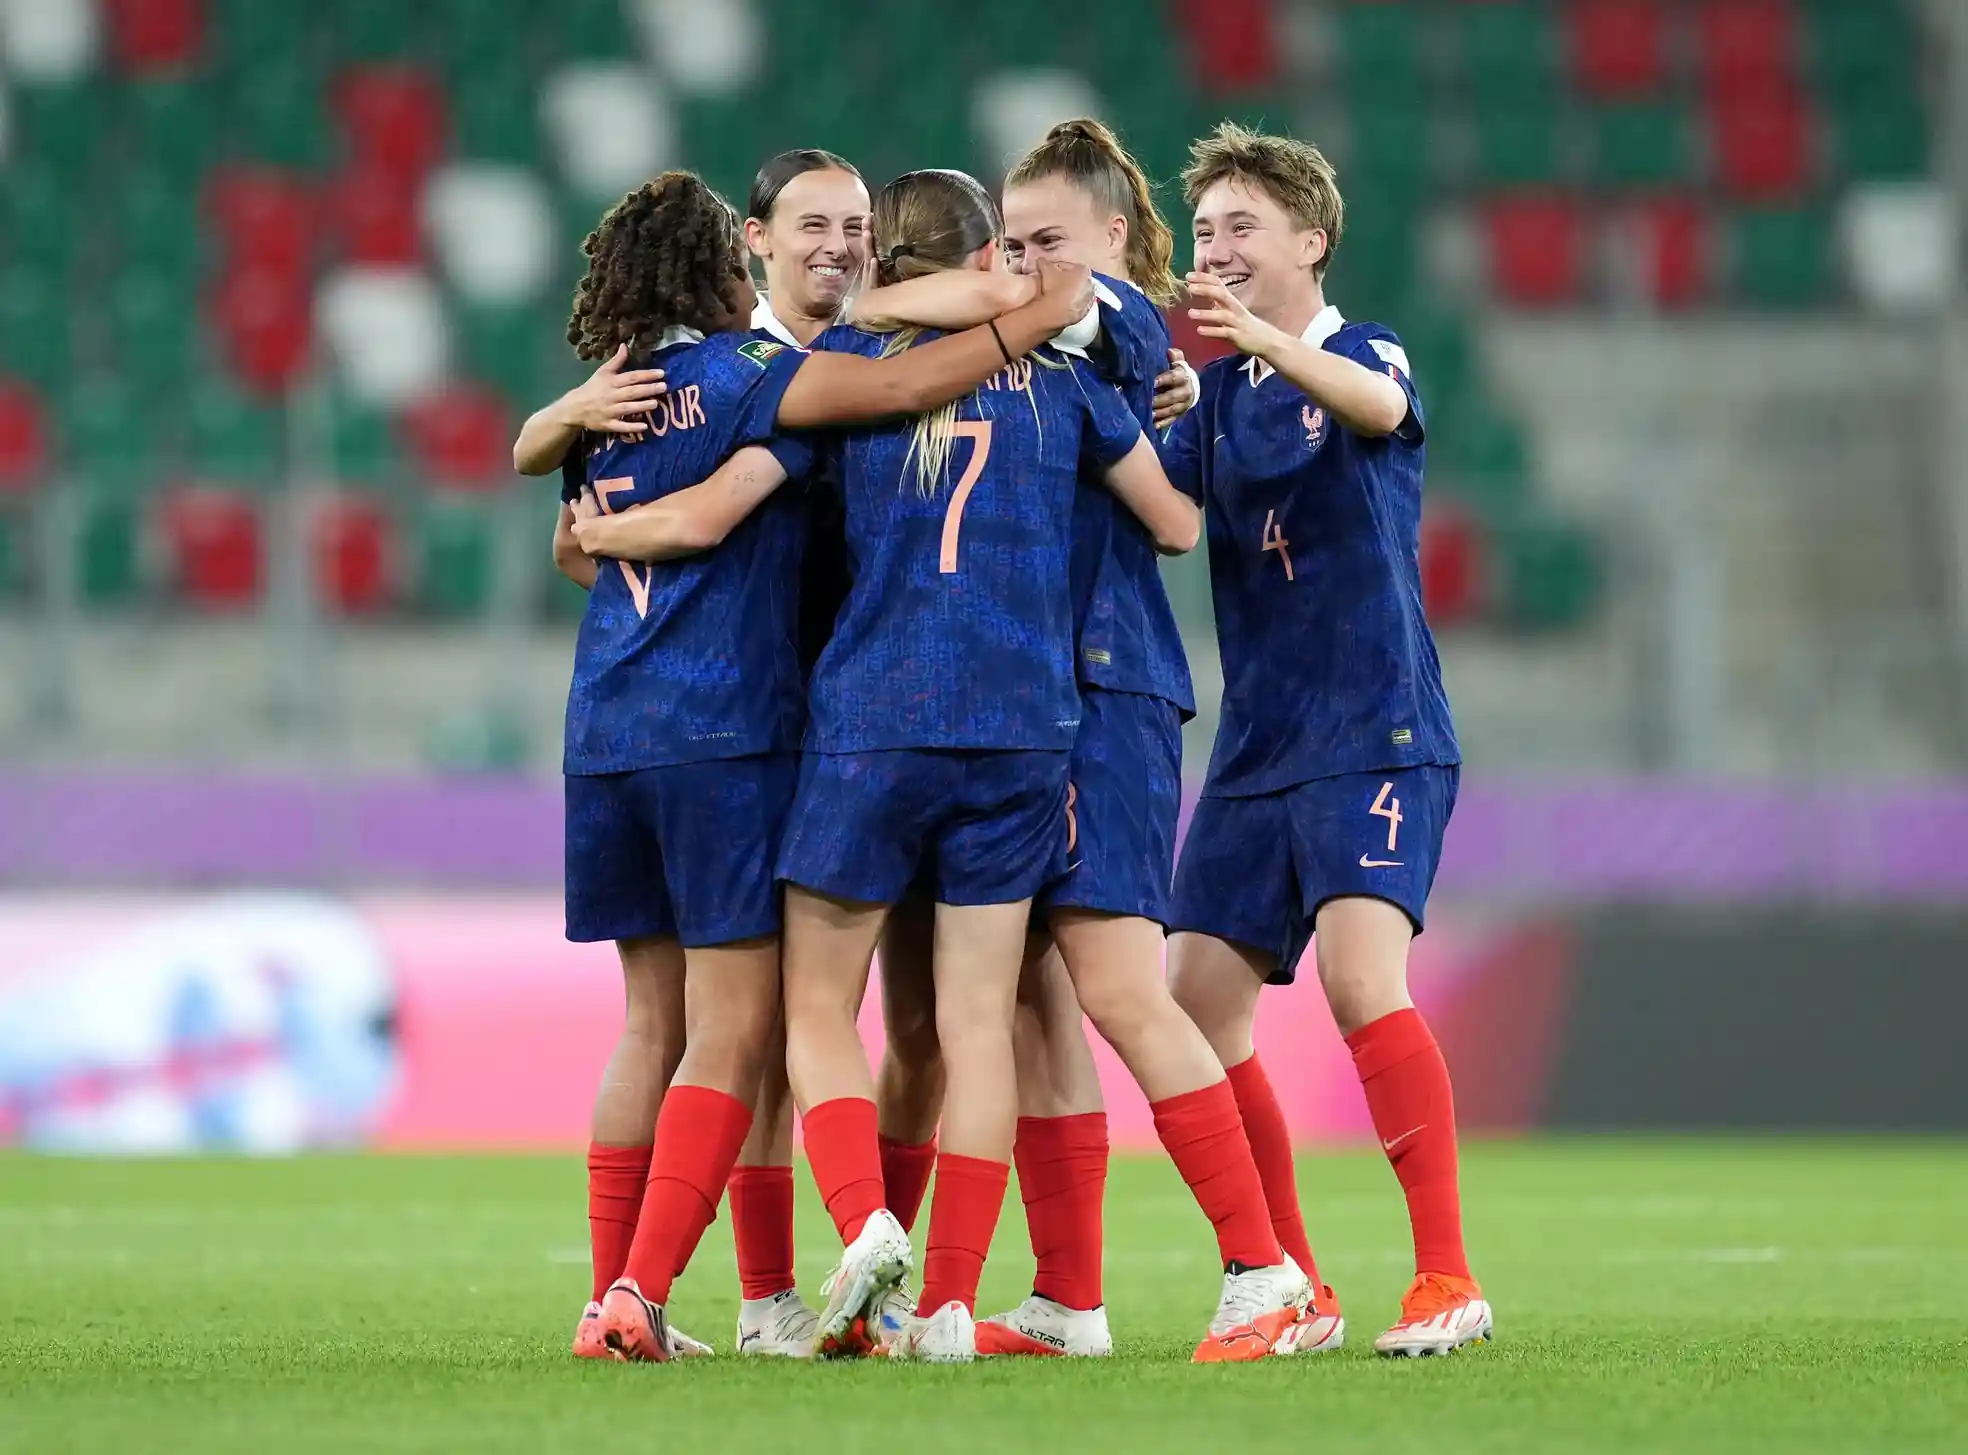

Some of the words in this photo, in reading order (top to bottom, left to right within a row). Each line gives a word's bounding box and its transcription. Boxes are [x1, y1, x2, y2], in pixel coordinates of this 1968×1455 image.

[930, 421, 992, 573] 7
[1261, 508, 1294, 581] 4
[1369, 782, 1402, 851] 4
[1019, 1325, 1066, 1349] ULTRA
